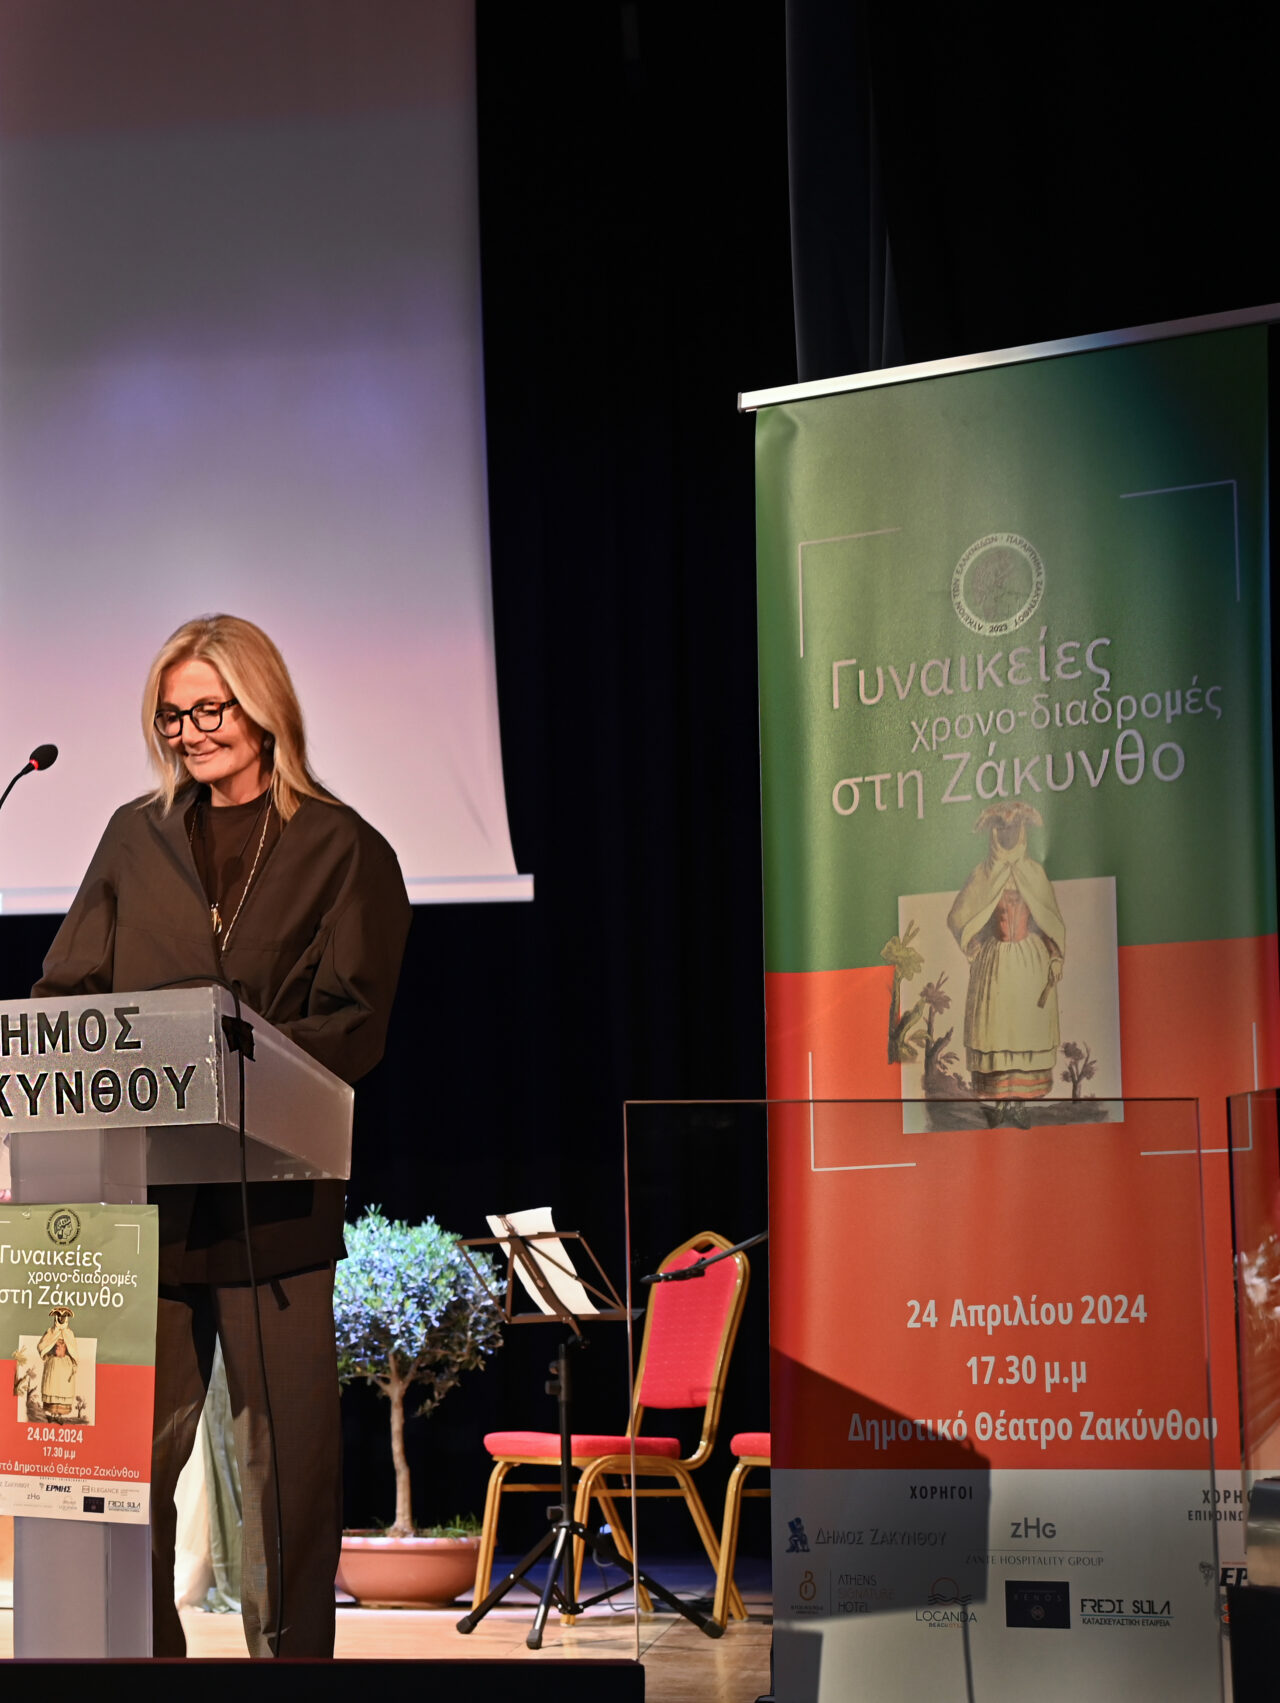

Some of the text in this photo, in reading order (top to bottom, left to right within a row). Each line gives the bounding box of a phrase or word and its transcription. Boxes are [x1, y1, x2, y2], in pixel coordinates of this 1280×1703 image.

[832, 626, 1111, 708] Γυναικείες
[910, 675, 1222, 753] χρονο-διαδρομές
[832, 729, 1185, 818] στη Ζάκυνθο
[0, 1245, 103, 1272] Γυναικείες
[27, 1269, 138, 1287] χρονο-διαδρομές
[38, 1284, 124, 1308] Ζάκυνθο
[906, 1294, 1148, 1335] 24 Απριλίου 2024
[966, 1354, 1087, 1392] 17.30 μ.μ
[27, 1427, 84, 1443] 24.04.2024
[847, 1409, 1218, 1450] Δημοτικό Θέατρο Ζακύνθου
[43, 1446, 63, 1458] 17.30
[14, 1460, 55, 1475] Δημοτικό
[56, 1463, 92, 1477] Θέατρο
[93, 1465, 140, 1479] Ζακύνθου
[910, 1486, 973, 1499] ΧΟΡΗΓΟΙ
[999, 1556, 1064, 1566] HOSPITALITY
[1068, 1557, 1104, 1566] GROUP
[915, 1609, 977, 1623] LOCANDA
[1080, 1599, 1170, 1615] FREDI SULA
